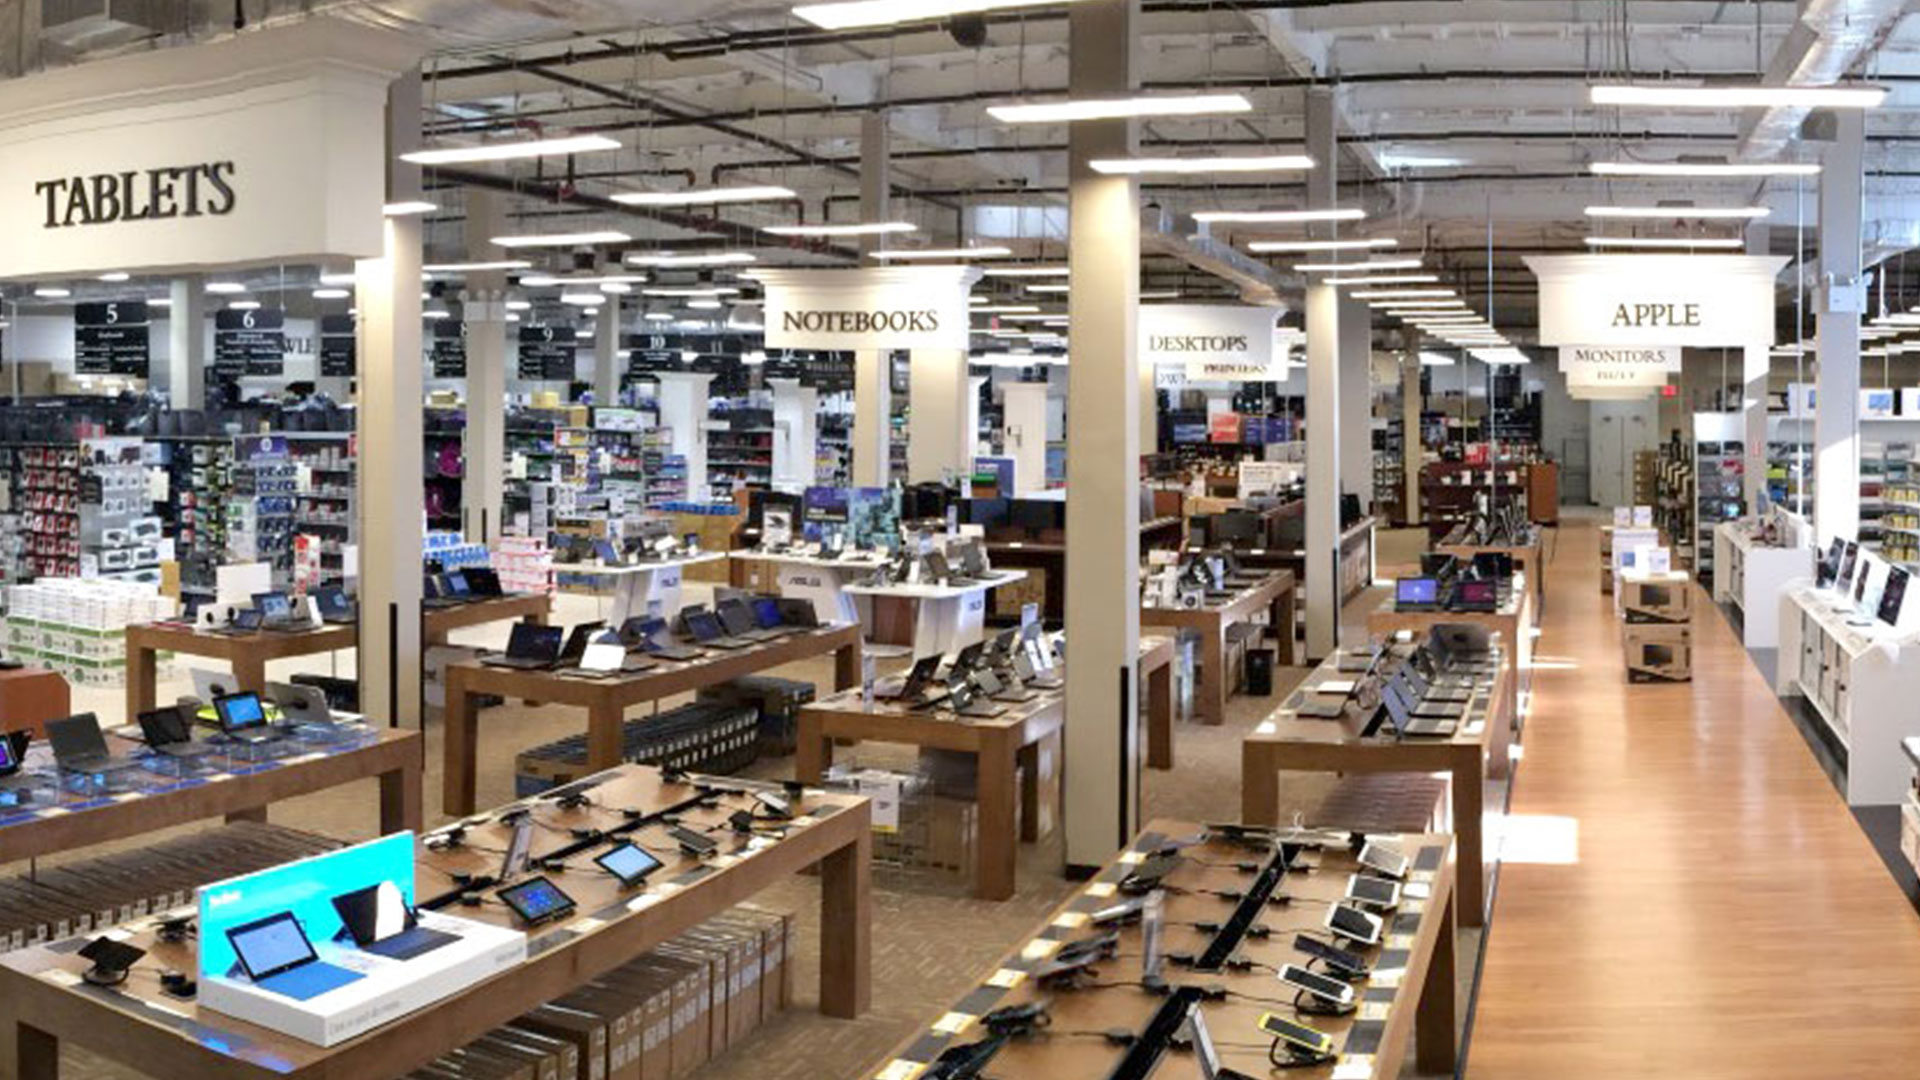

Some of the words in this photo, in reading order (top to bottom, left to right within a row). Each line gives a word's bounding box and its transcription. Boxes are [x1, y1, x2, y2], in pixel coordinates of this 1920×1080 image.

[35, 161, 236, 228] TABLETS
[106, 304, 118, 325] 5
[243, 311, 255, 329] 6
[783, 310, 939, 332] NOTEBOOKS
[1611, 303, 1701, 327] APPLE
[542, 328, 553, 342] 9
[650, 336, 666, 350] 10
[1149, 335, 1248, 352] DESKTOPS
[1574, 349, 1667, 363] MONITORS
